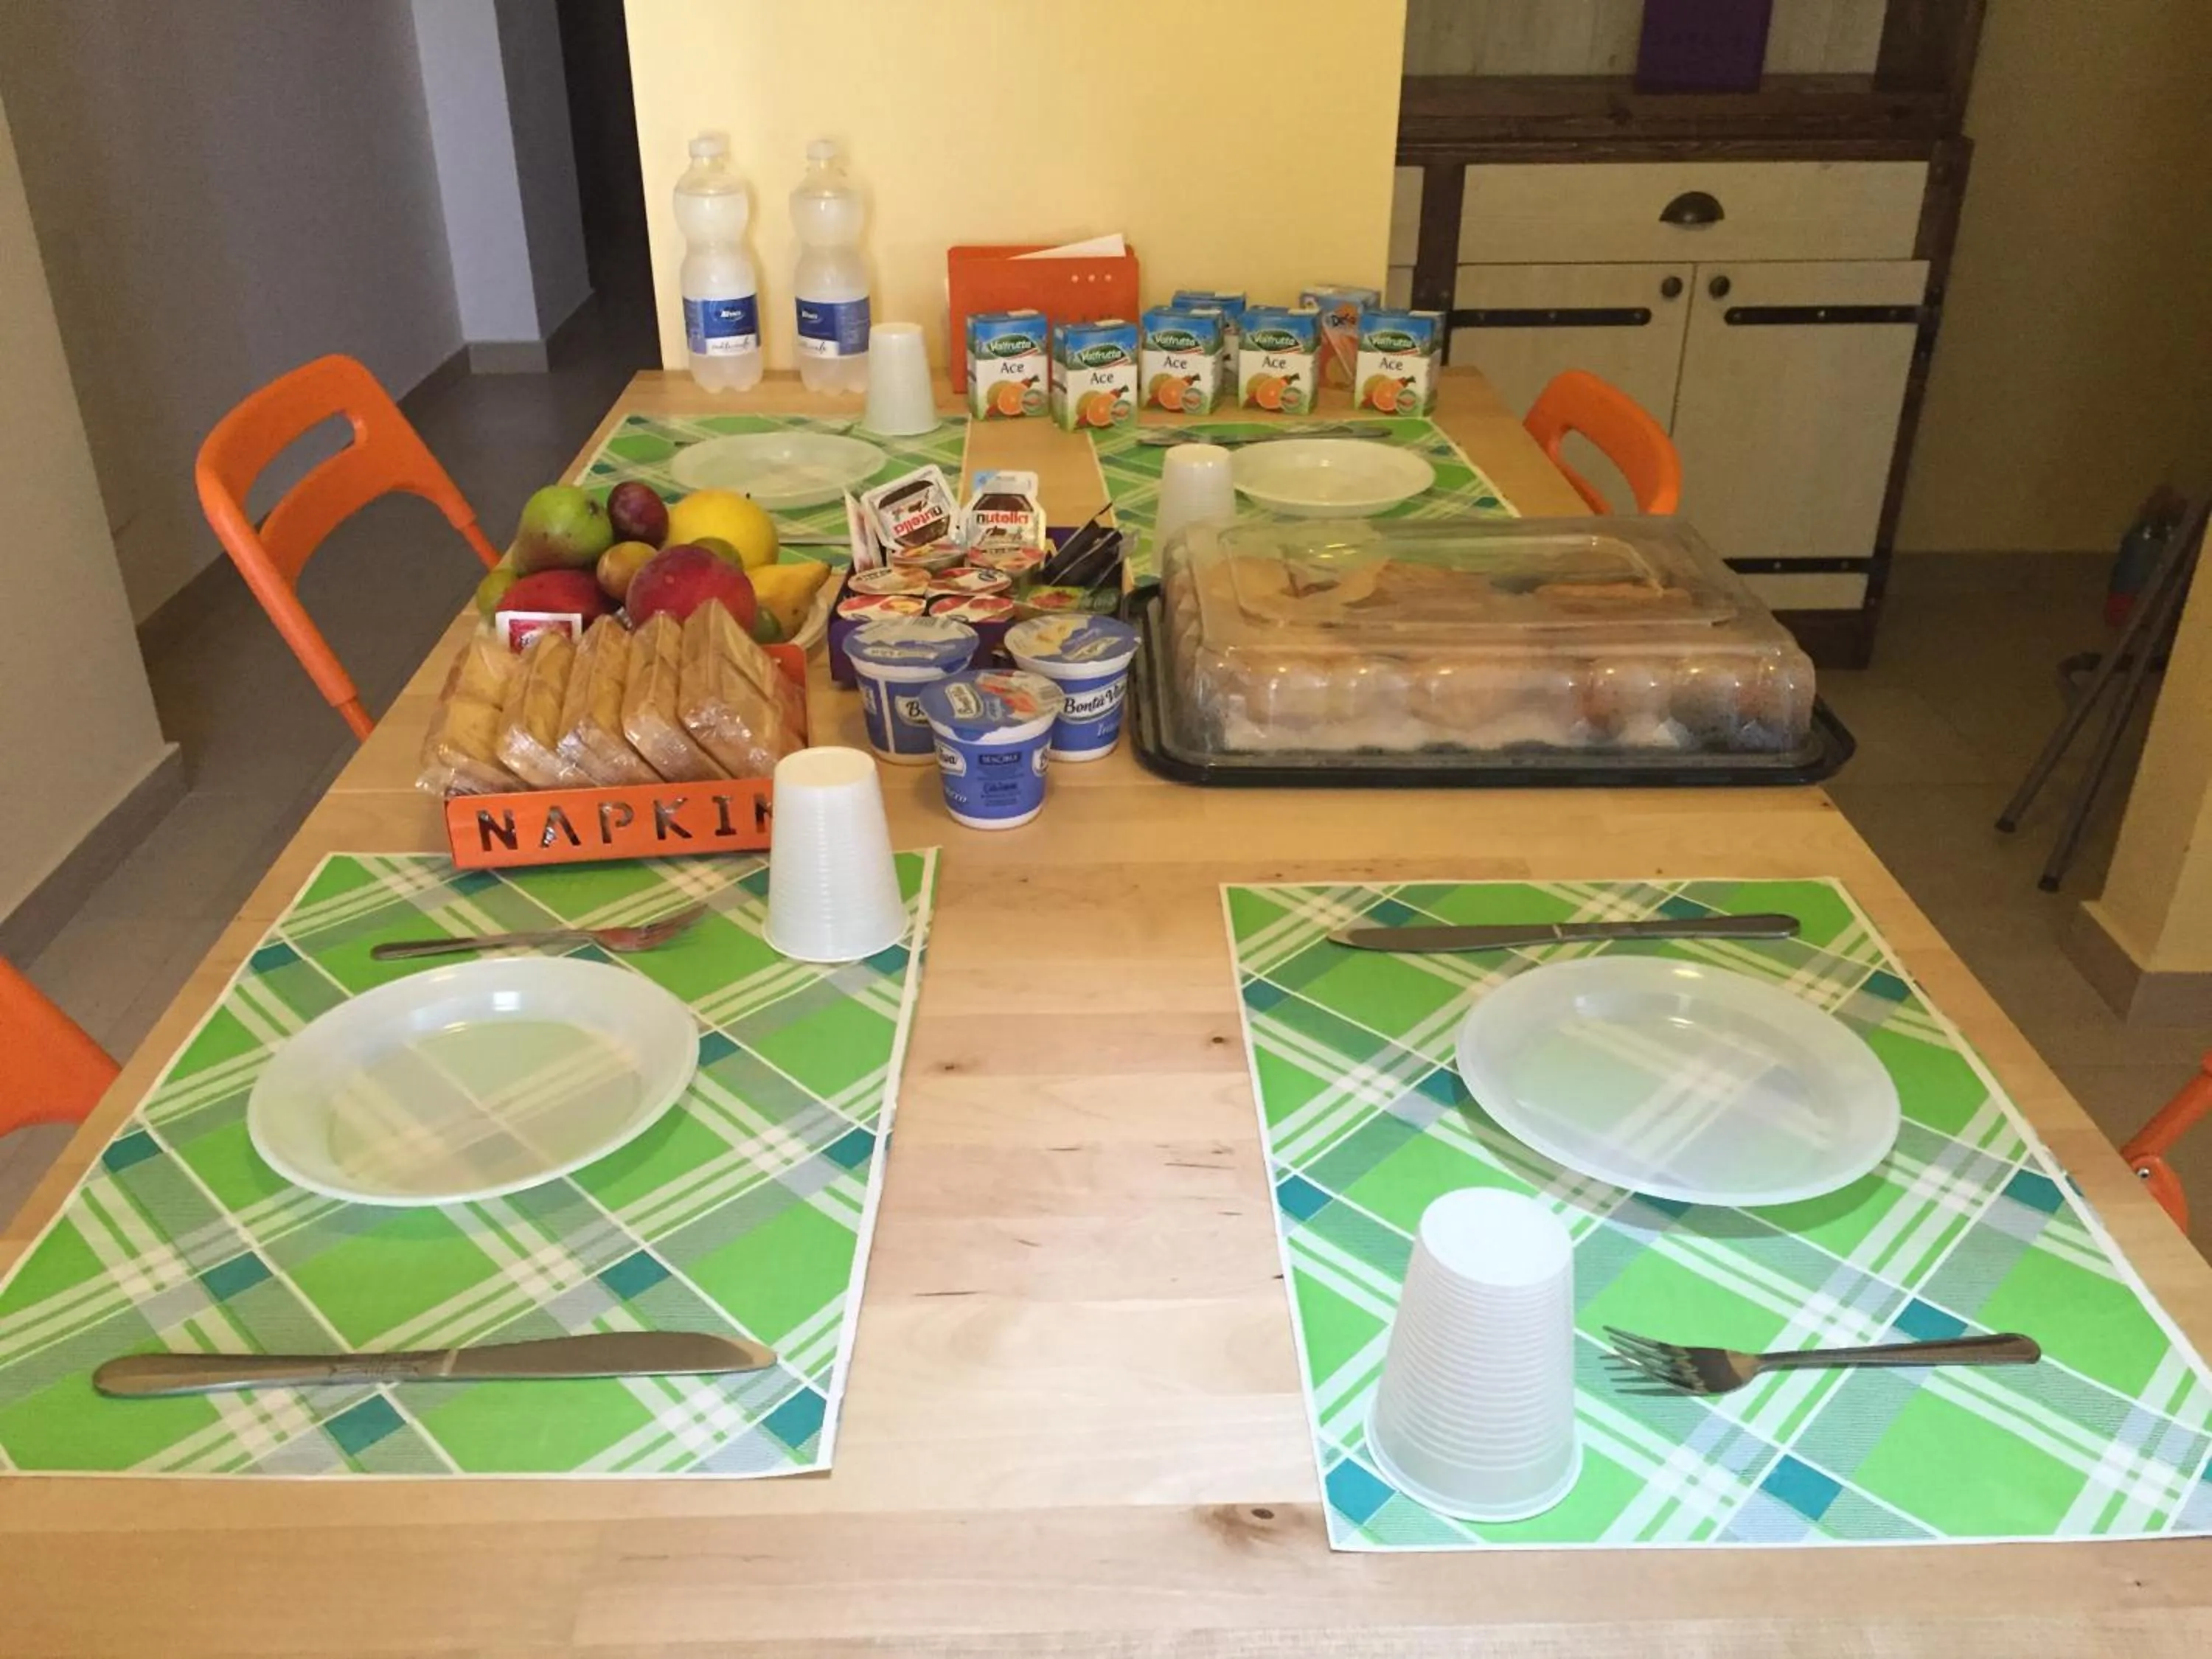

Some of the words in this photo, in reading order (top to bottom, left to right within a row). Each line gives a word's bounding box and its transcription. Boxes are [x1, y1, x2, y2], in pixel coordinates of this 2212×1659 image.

[990, 339, 1032, 352] Valfrutta
[1080, 349, 1122, 361] Valfrutta
[1000, 362, 1025, 375] Ace
[1163, 356, 1188, 369] Ace
[1262, 356, 1287, 369] Ace
[1379, 357, 1405, 371] Ace
[1090, 372, 1115, 384] Ace
[894, 505, 943, 535] nutella
[976, 510, 1029, 524] nutella
